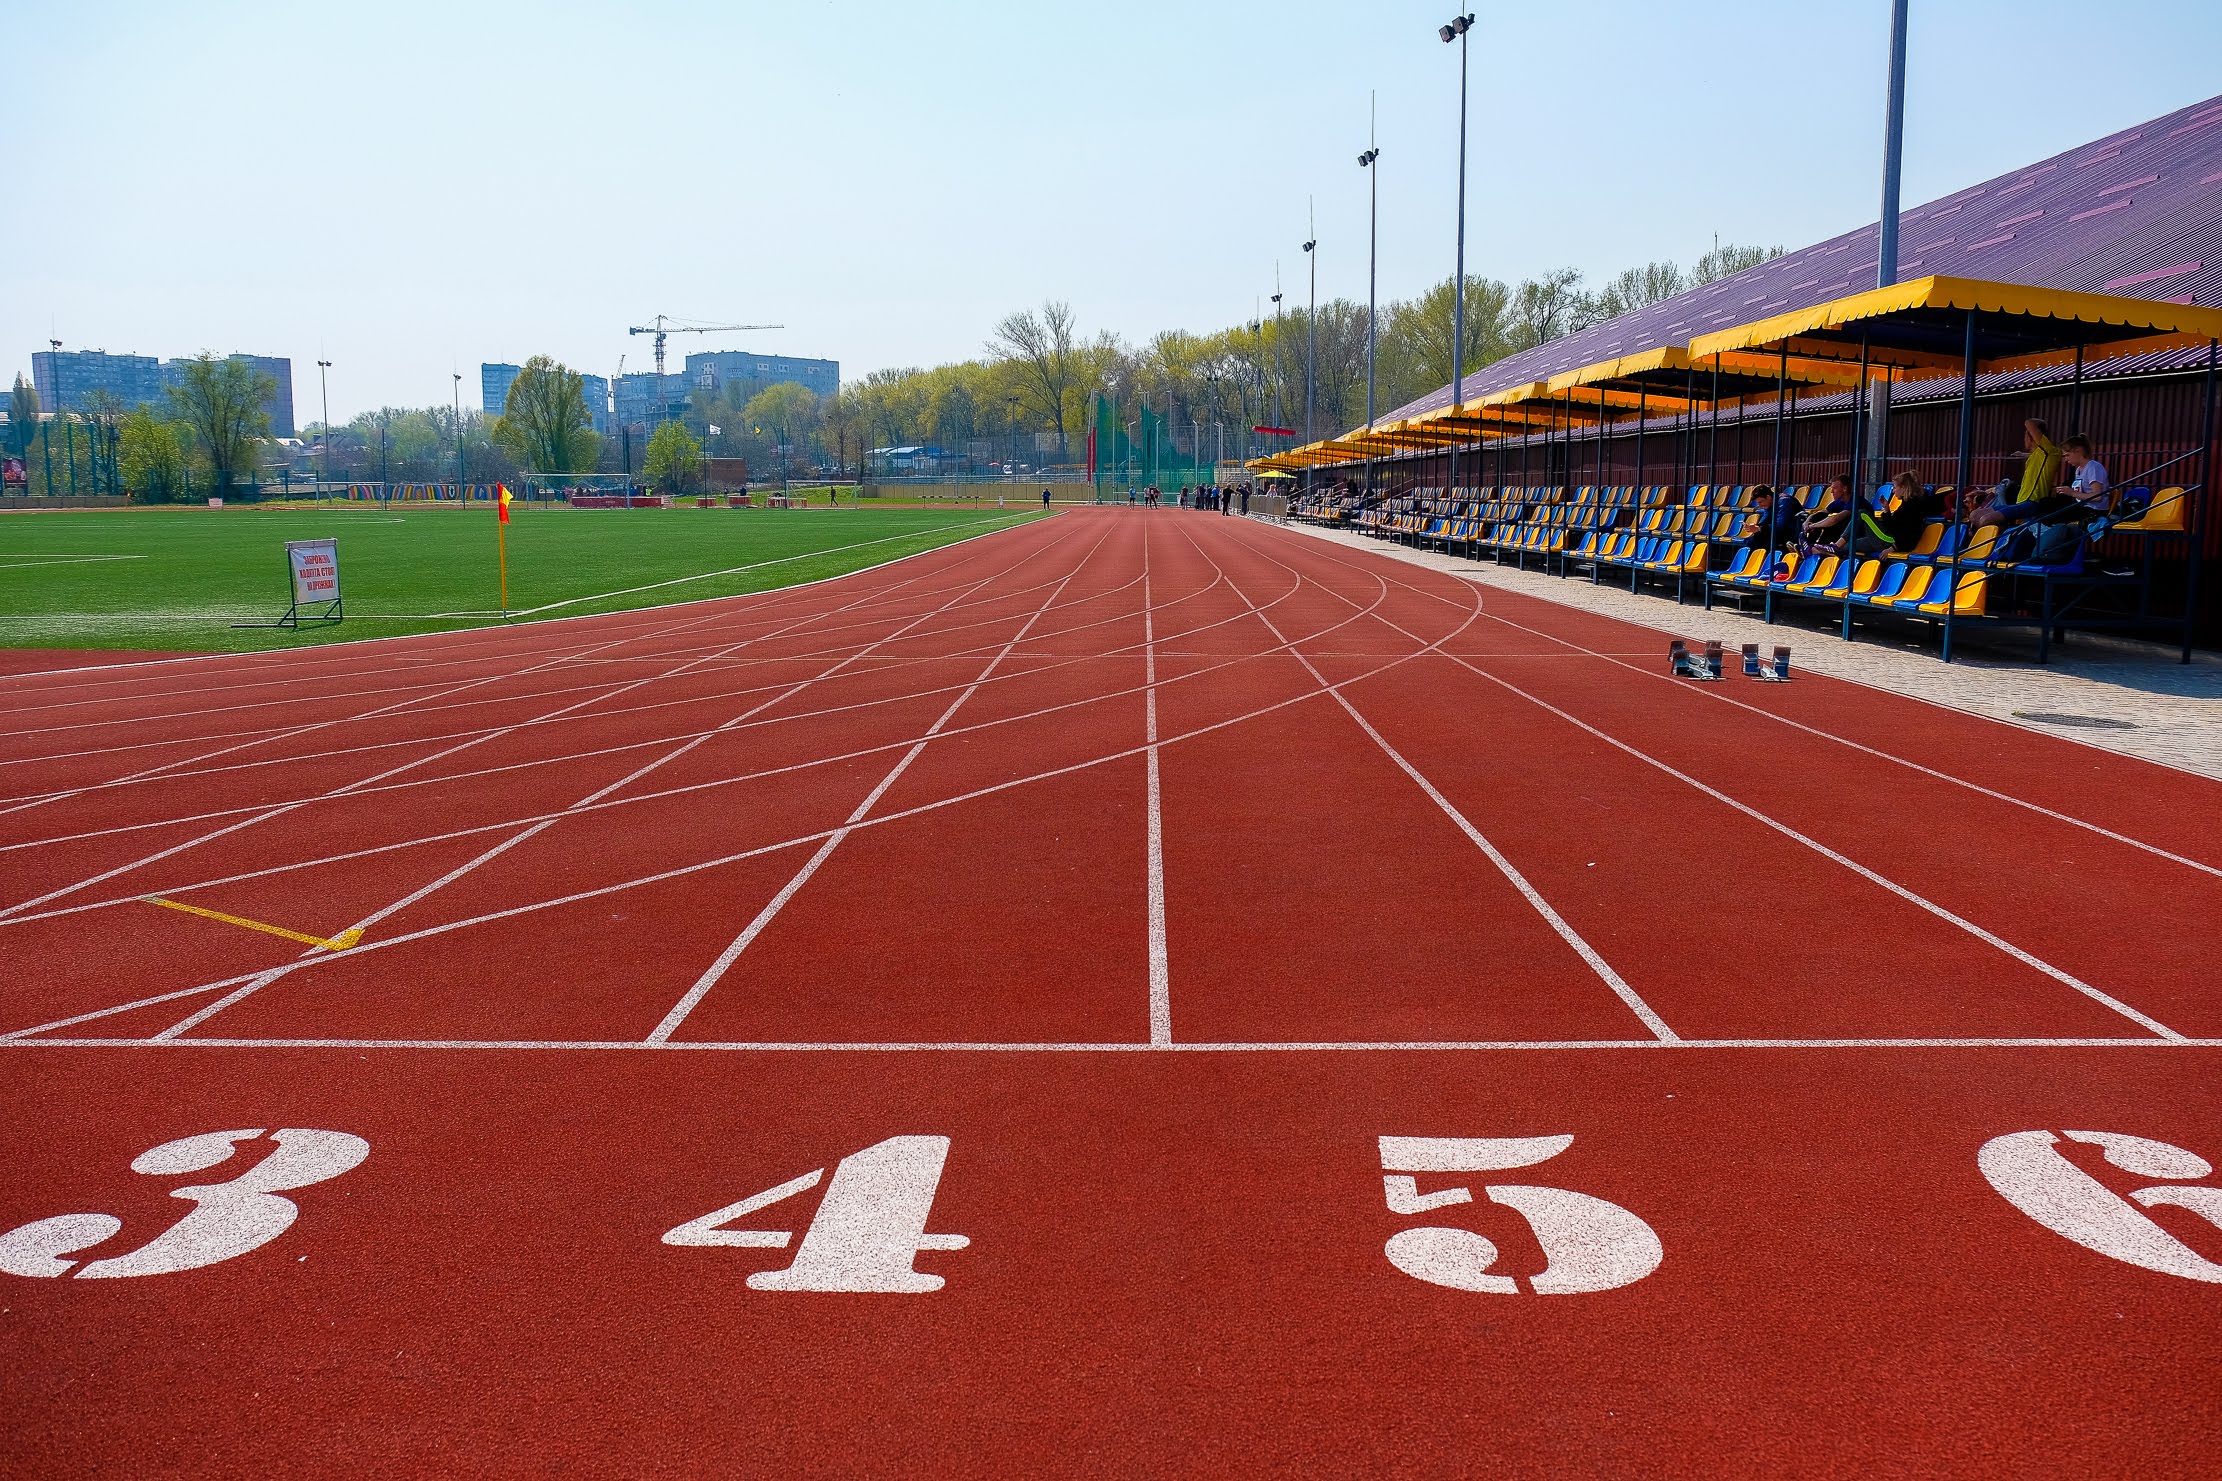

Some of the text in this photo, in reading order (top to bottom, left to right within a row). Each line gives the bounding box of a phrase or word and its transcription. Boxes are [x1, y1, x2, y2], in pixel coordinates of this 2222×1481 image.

[0, 1127, 370, 1279] 3
[661, 1135, 971, 1293] 4
[1378, 1134, 1664, 1295] 5
[1976, 1129, 2222, 1284] 6
